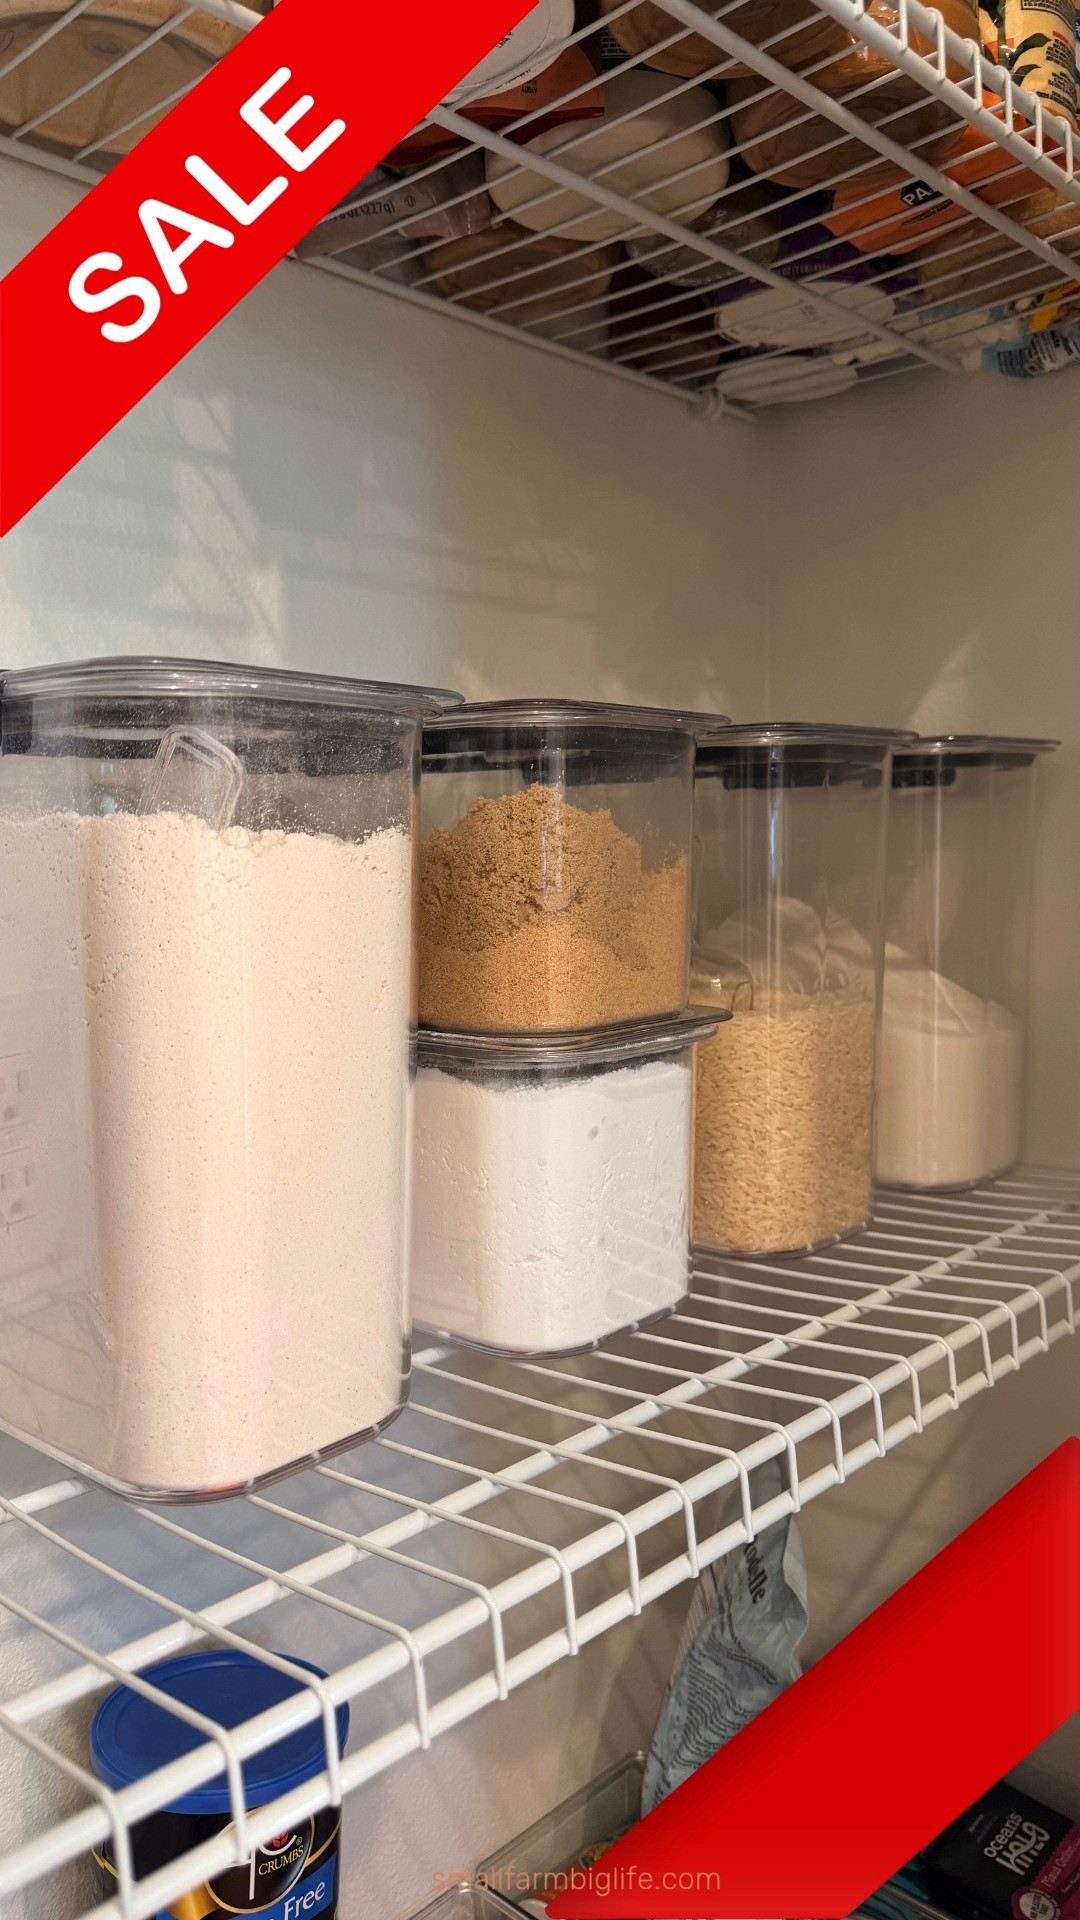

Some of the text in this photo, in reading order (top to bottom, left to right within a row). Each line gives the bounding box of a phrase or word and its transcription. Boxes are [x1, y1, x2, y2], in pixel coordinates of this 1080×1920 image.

[901, 187, 934, 206] PA
[258, 1844, 304, 1876] CRUMBS
[283, 1881, 326, 1920] Free
